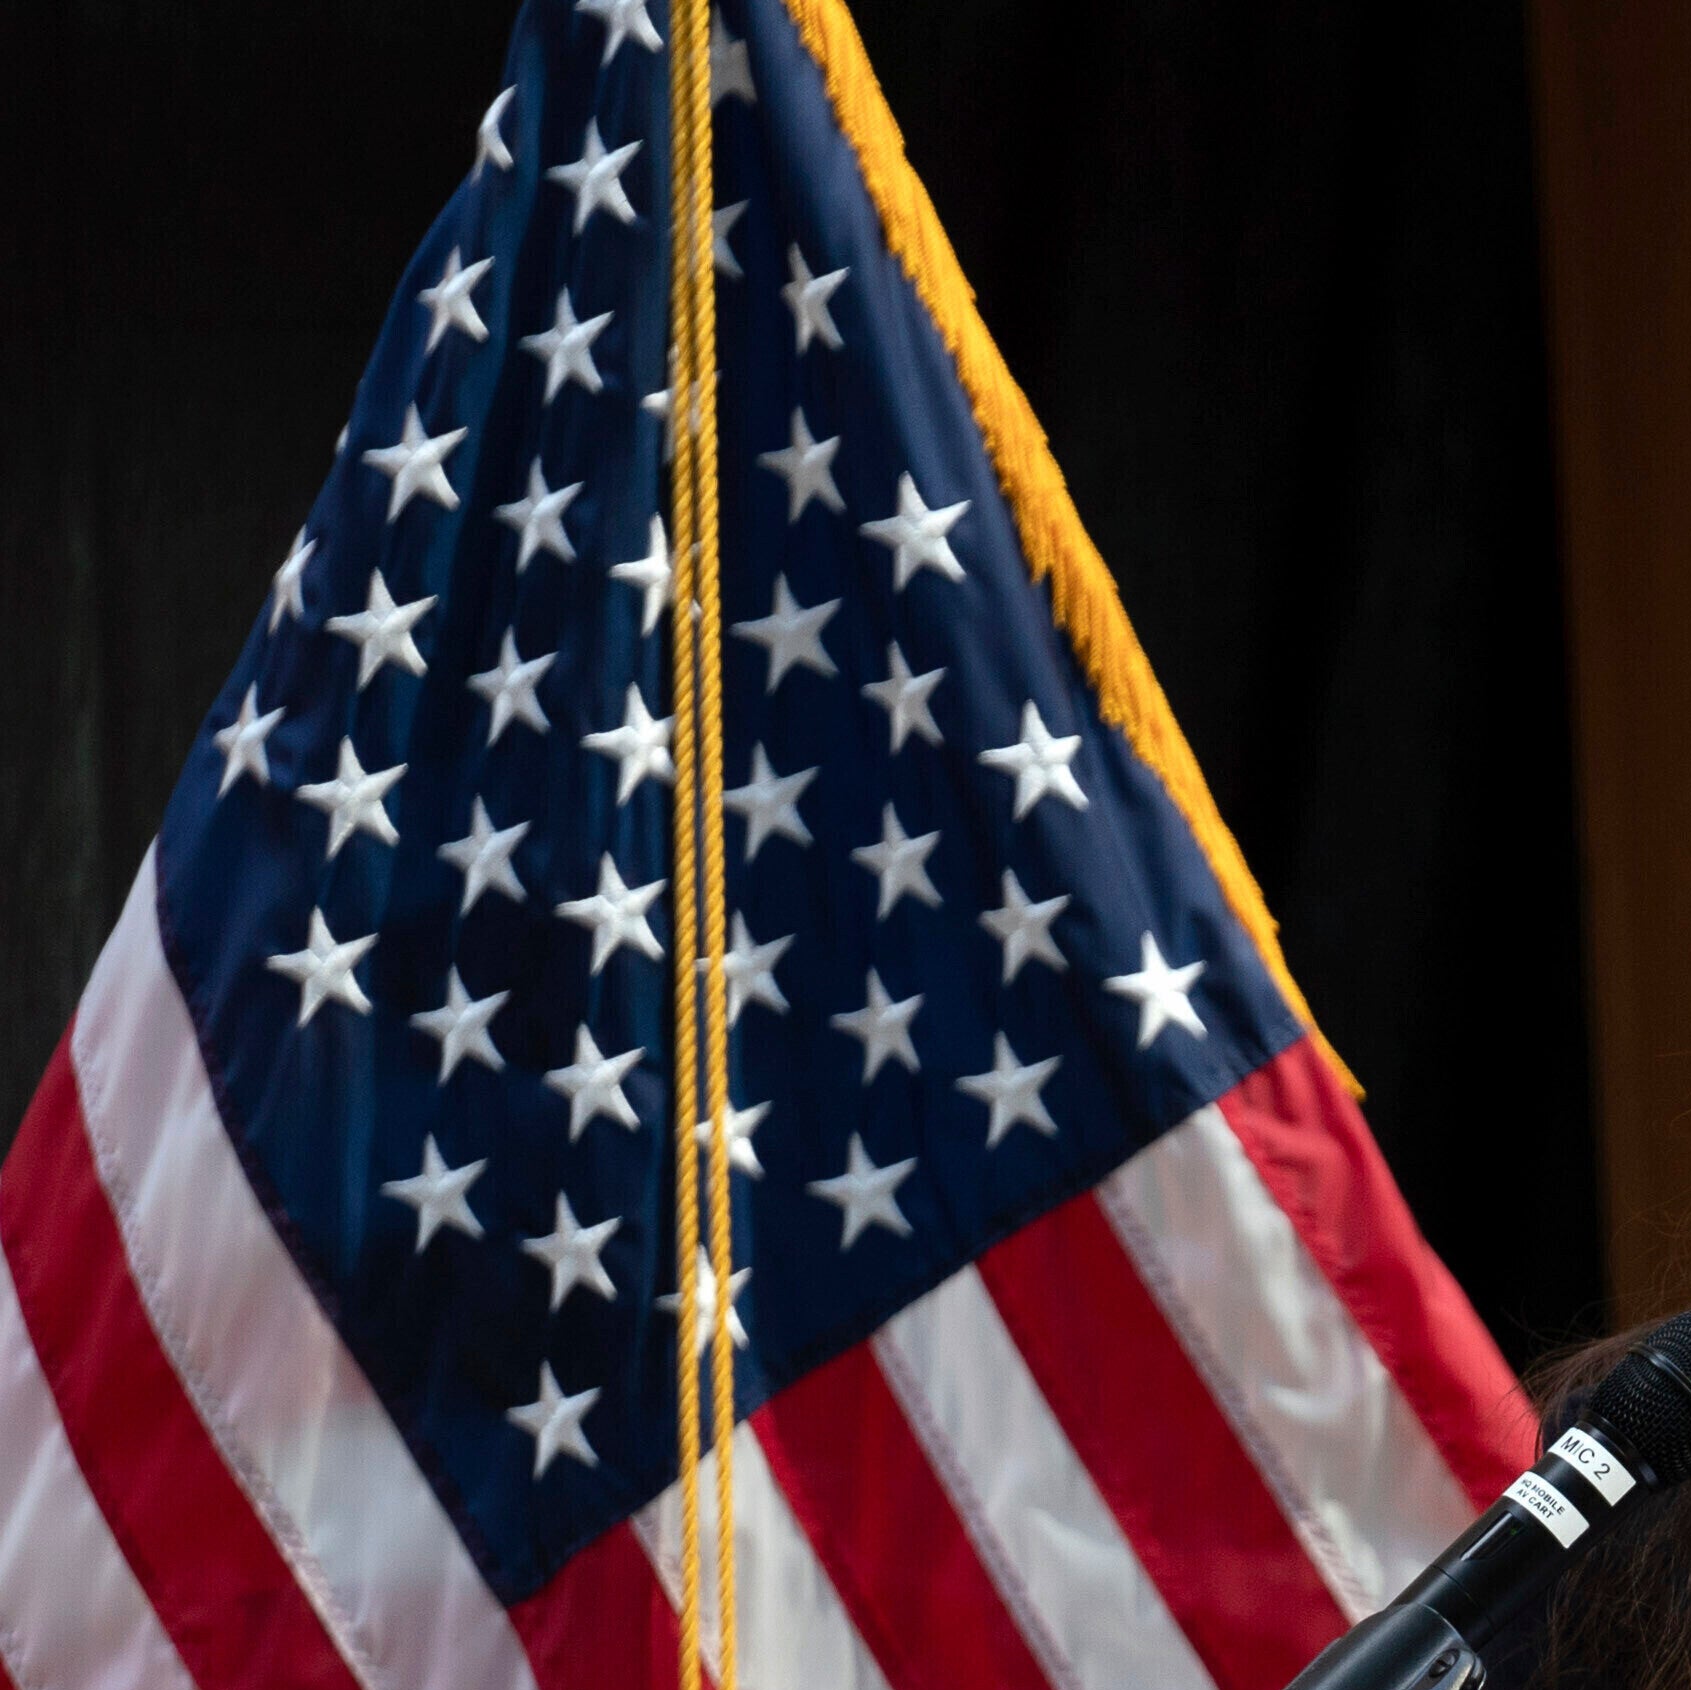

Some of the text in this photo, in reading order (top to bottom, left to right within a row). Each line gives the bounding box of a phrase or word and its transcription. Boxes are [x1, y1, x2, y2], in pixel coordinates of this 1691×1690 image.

[1561, 1436, 1611, 1481] MIC 2
[1517, 1489, 1555, 1518] AV CART
[1531, 1484, 1566, 1515] MOBILE
